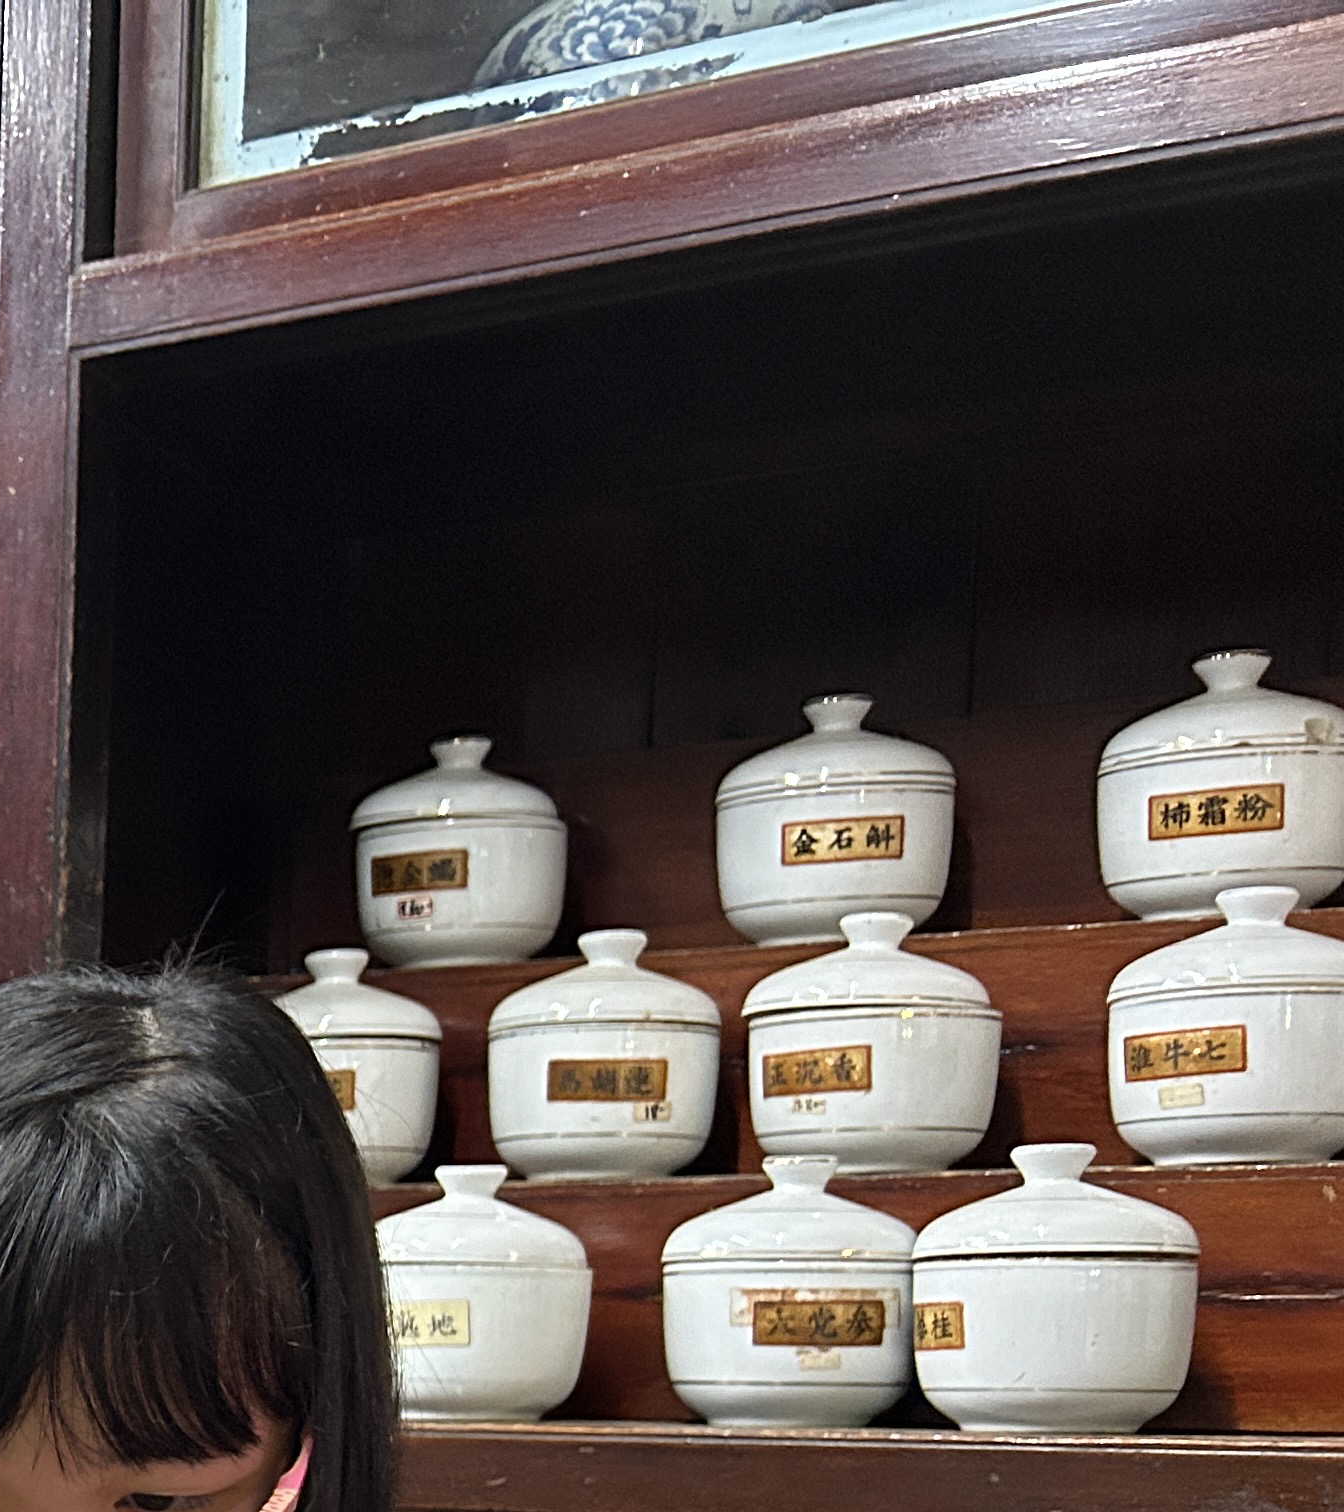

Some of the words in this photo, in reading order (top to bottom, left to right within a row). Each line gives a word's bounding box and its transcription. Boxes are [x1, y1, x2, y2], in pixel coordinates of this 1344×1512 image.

[1160, 791, 1276, 831] 柿霜粉
[791, 823, 898, 858] 金石斛
[769, 1052, 859, 1087] 正沉香
